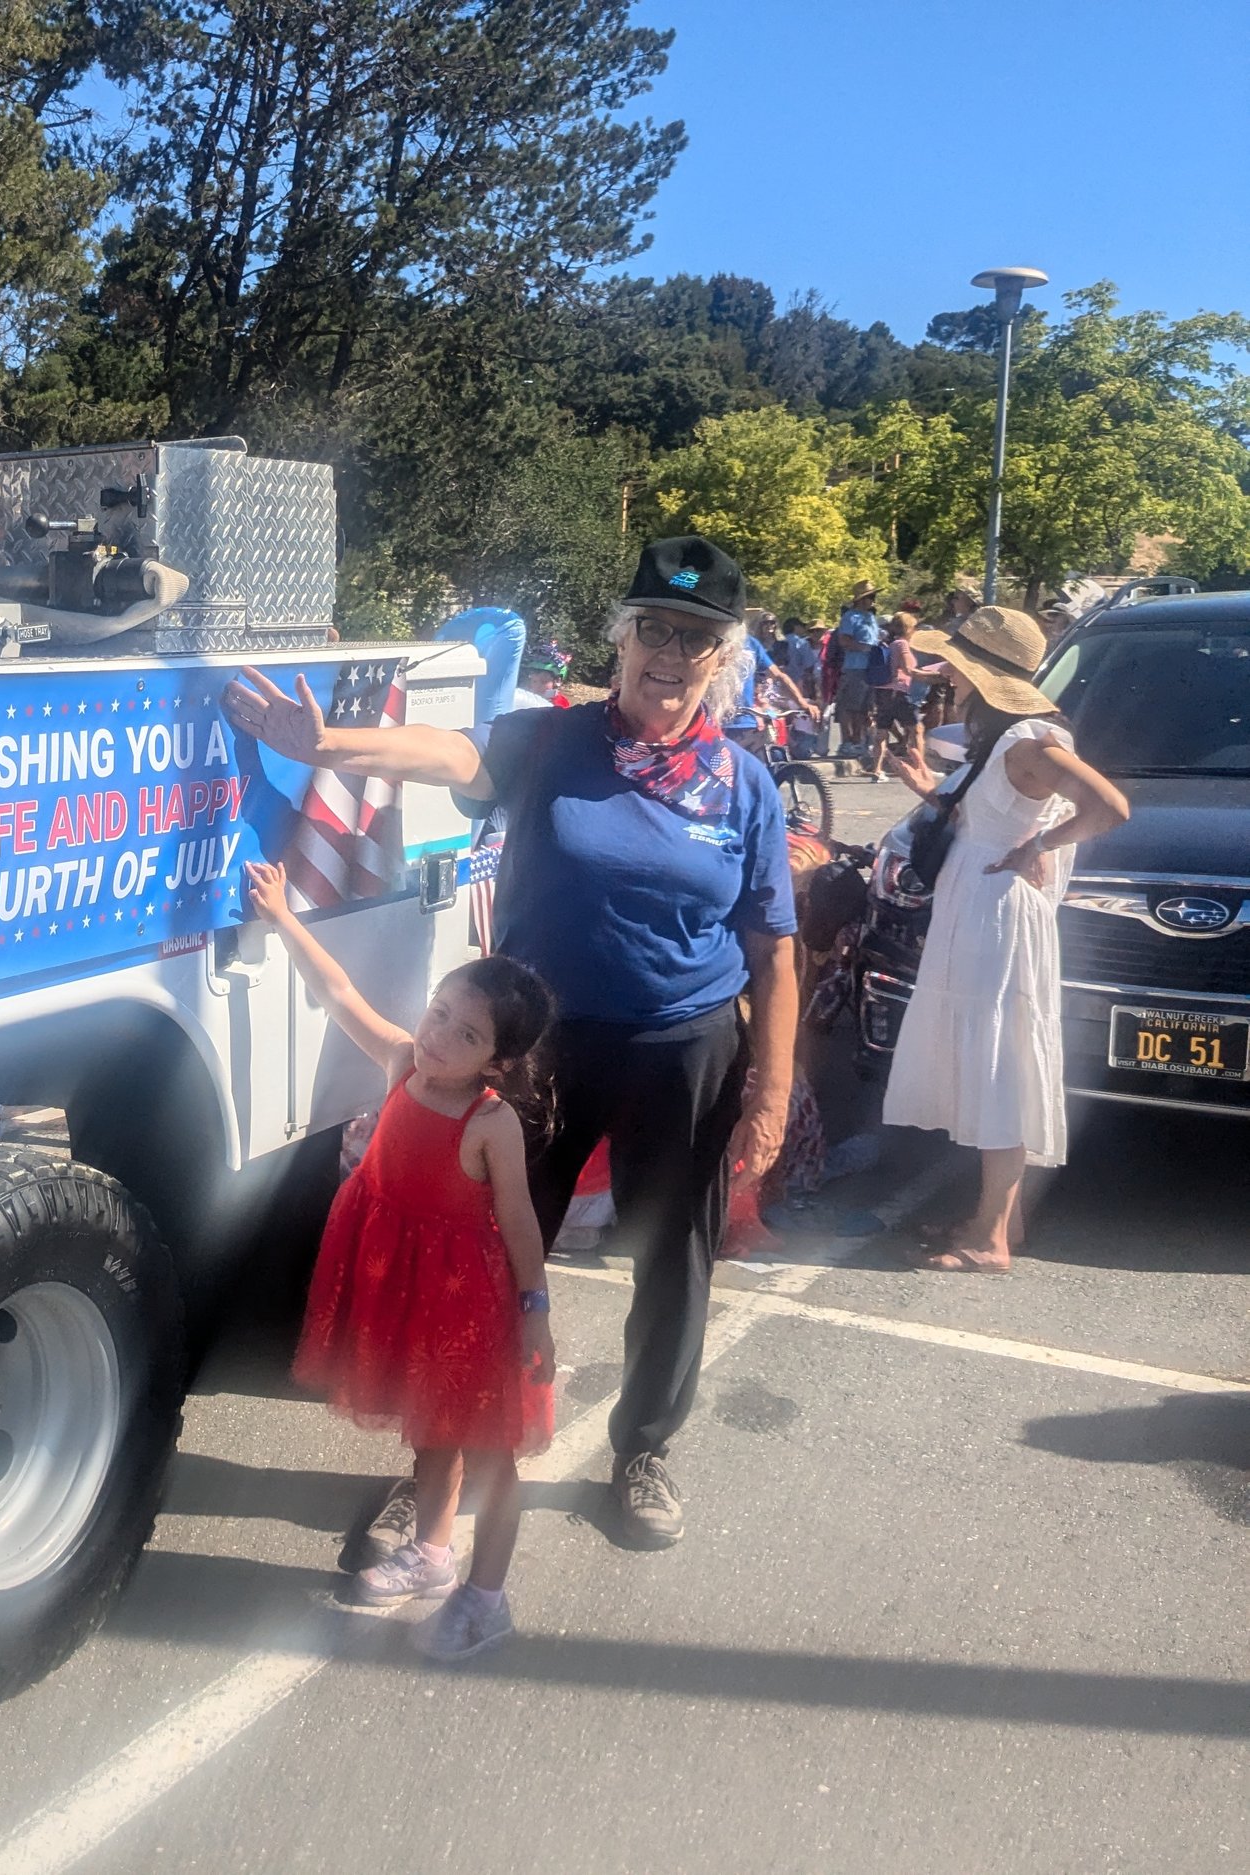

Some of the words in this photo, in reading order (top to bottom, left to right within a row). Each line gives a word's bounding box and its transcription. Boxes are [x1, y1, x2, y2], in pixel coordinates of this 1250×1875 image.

[20, 628, 34, 640] HOSE
[34, 626, 48, 637] TRAY
[411, 696, 433, 706] BACKPACK
[435, 694, 450, 704] PUMPS
[125, 721, 195, 775] YOU
[204, 720, 229, 767] A
[47, 790, 129, 851] AND
[138, 774, 252, 837] HAPPY
[112, 846, 161, 900] OF
[164, 832, 241, 891] JULY
[1145, 1009, 1186, 1021] WALNUT
[1187, 1014, 1220, 1024] CREEK
[1146, 1019, 1220, 1033] CALIFORNIA
[1136, 1031, 1172, 1062] DC
[1190, 1036, 1225, 1069] 51
[1141, 1061, 1218, 1076] DIABLOSUBARU
[1221, 1069, 1241, 1078] .COM
